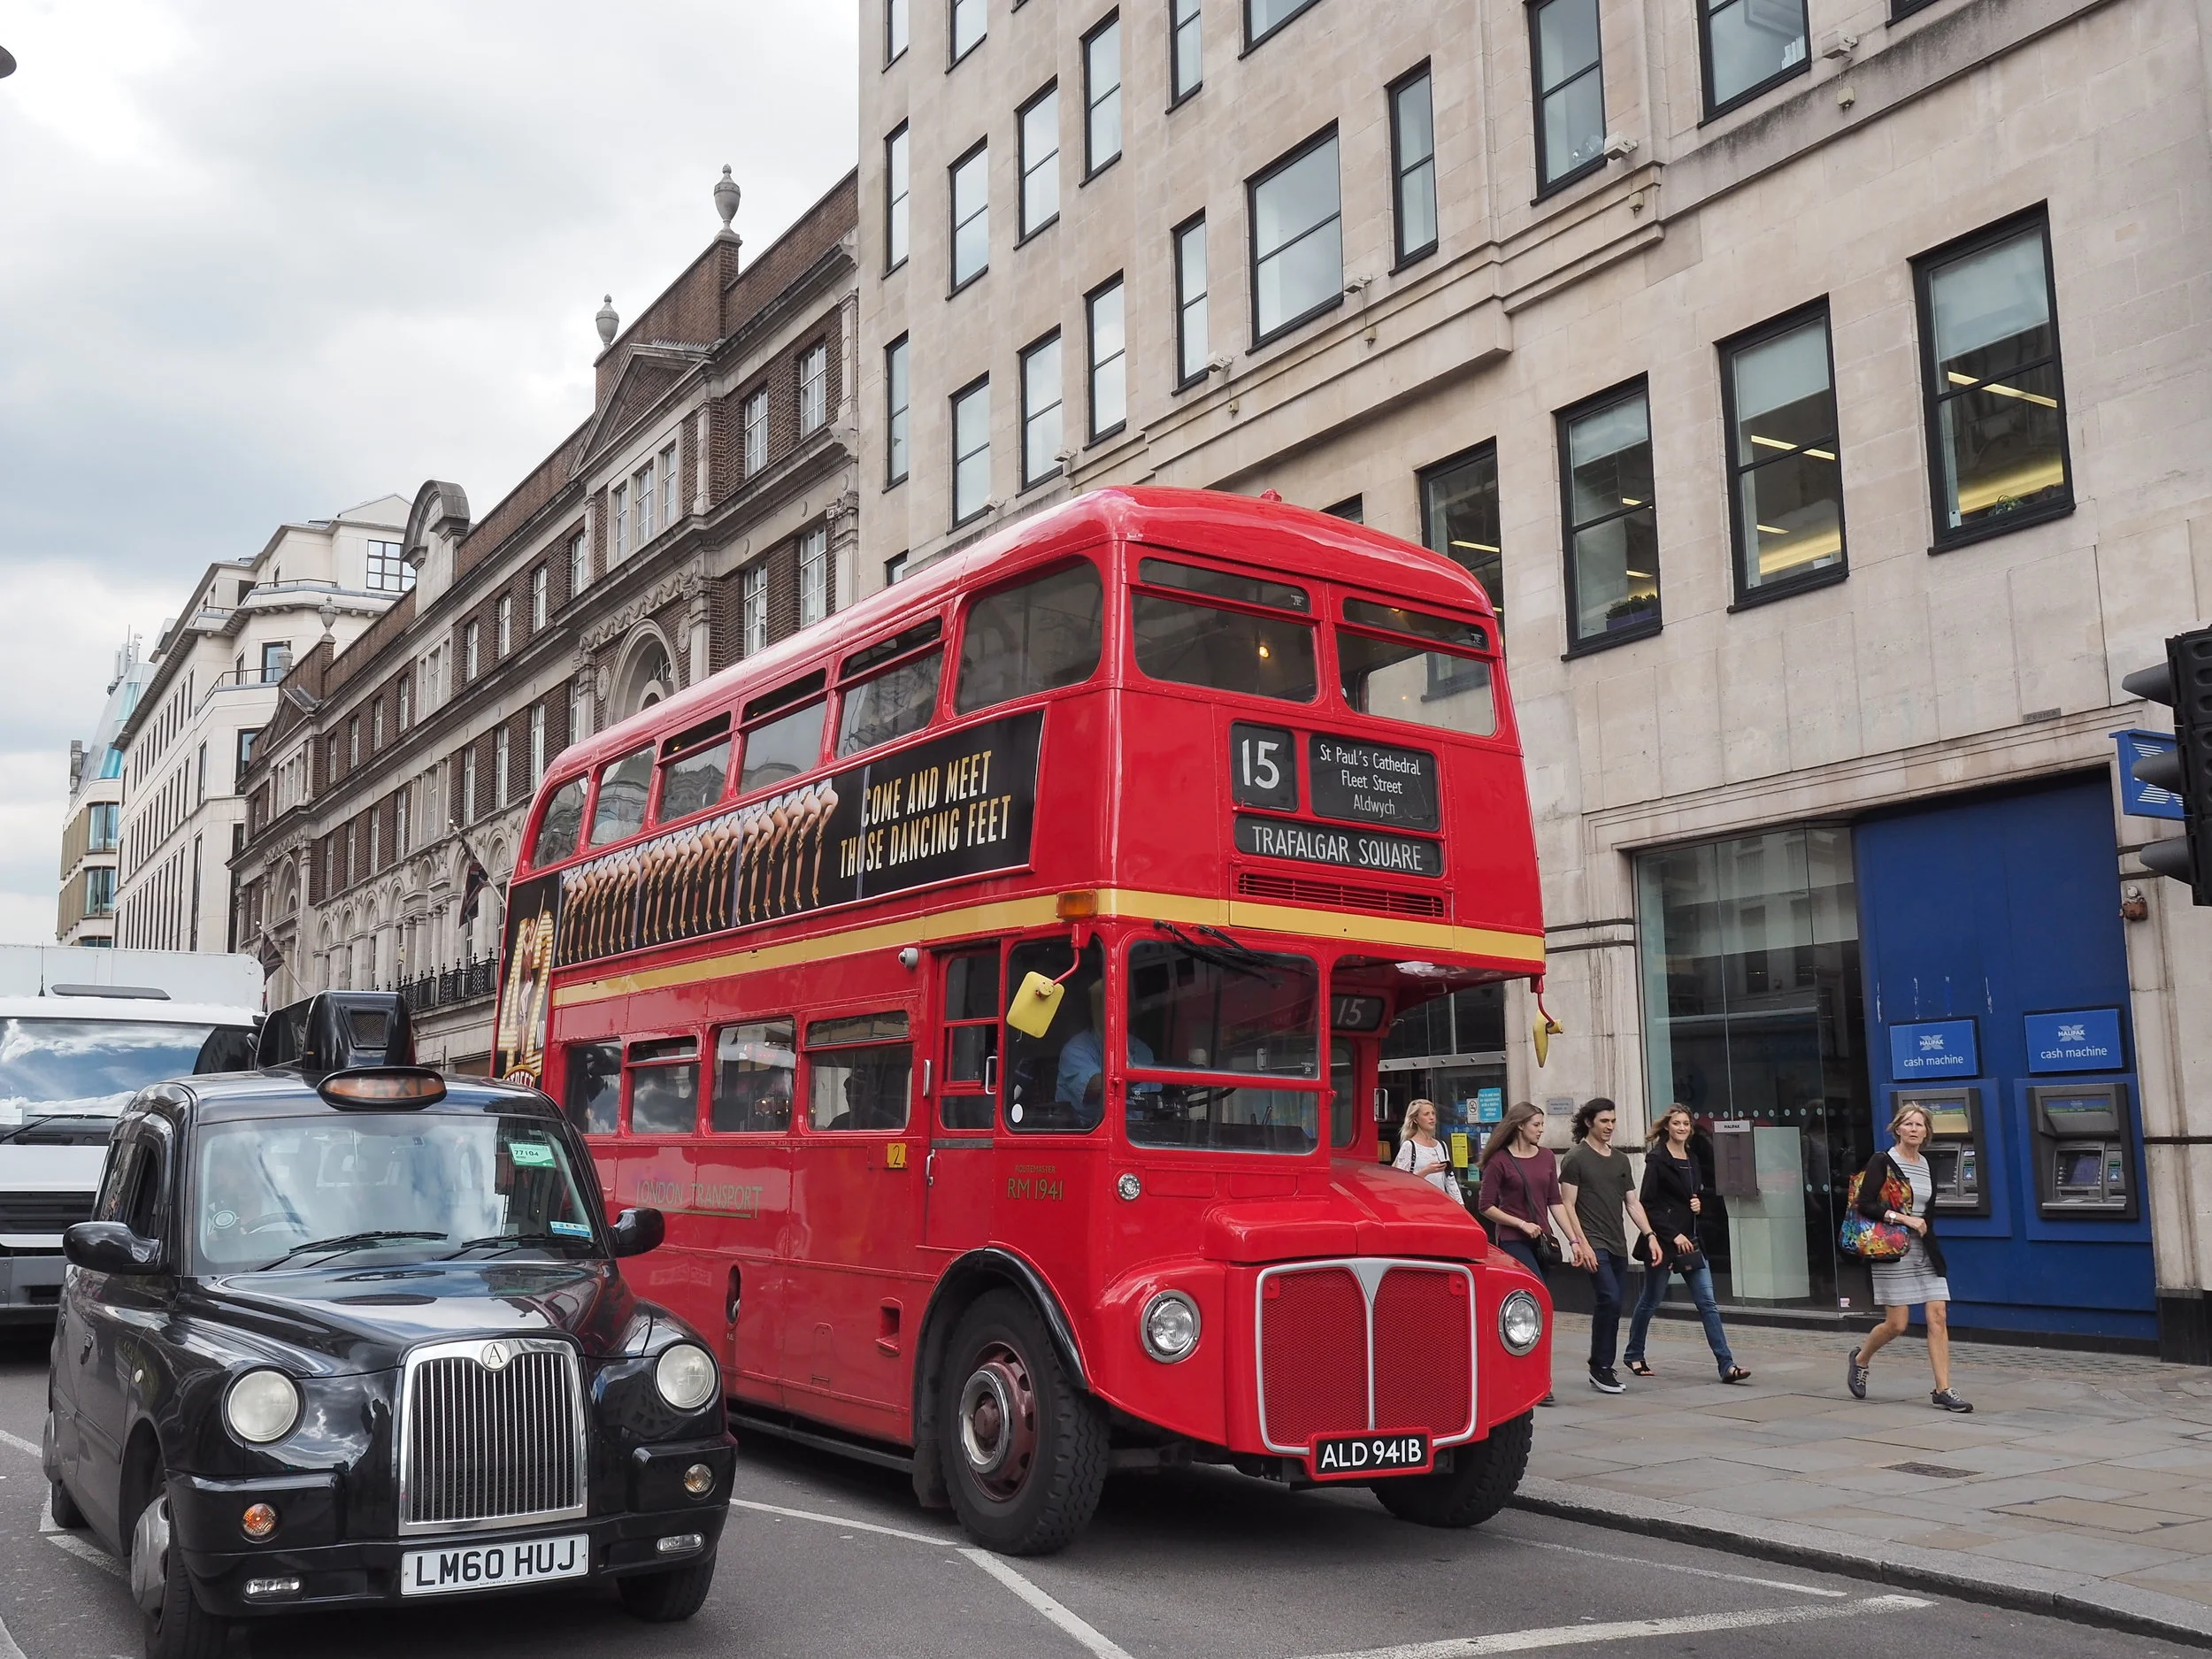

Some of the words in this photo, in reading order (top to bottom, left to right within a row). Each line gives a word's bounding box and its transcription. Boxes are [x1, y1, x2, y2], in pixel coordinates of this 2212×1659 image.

[1241, 739, 1280, 789] 15
[1320, 743, 1332, 761] St
[1336, 746, 1369, 767] Paul's
[1372, 752, 1422, 776] Cathedral
[862, 778, 902, 828] COME
[906, 766, 939, 815] AND
[944, 749, 992, 804] MEET
[1341, 769, 1369, 789] Fleet
[1372, 774, 1403, 795] Street
[1353, 793, 1395, 818] Aldwych
[841, 829, 884, 879] THOSE
[888, 807, 960, 866] DANCING
[966, 795, 1011, 847] FEET
[1252, 826, 1350, 863] TRAFALGAR
[1358, 838, 1423, 871] SQUARE
[1337, 998, 1366, 1025] 15
[1903, 1056, 1924, 1067] cash
[1926, 1054, 1964, 1065] machine
[2040, 1048, 2063, 1059] cash
[2066, 1045, 2108, 1057] machine
[893, 1144, 901, 1165] 2
[636, 1180, 684, 1205] LONDON
[690, 1181, 764, 1218] TRANSPORT
[1007, 1177, 1030, 1199] RM
[1034, 1179, 1064, 1201] 1941
[487, 1343, 505, 1364] A
[1320, 1441, 1369, 1469] ALD
[1372, 1438, 1422, 1465] 941B
[416, 1548, 504, 1586] LM60
[515, 1540, 575, 1576] HUJ
